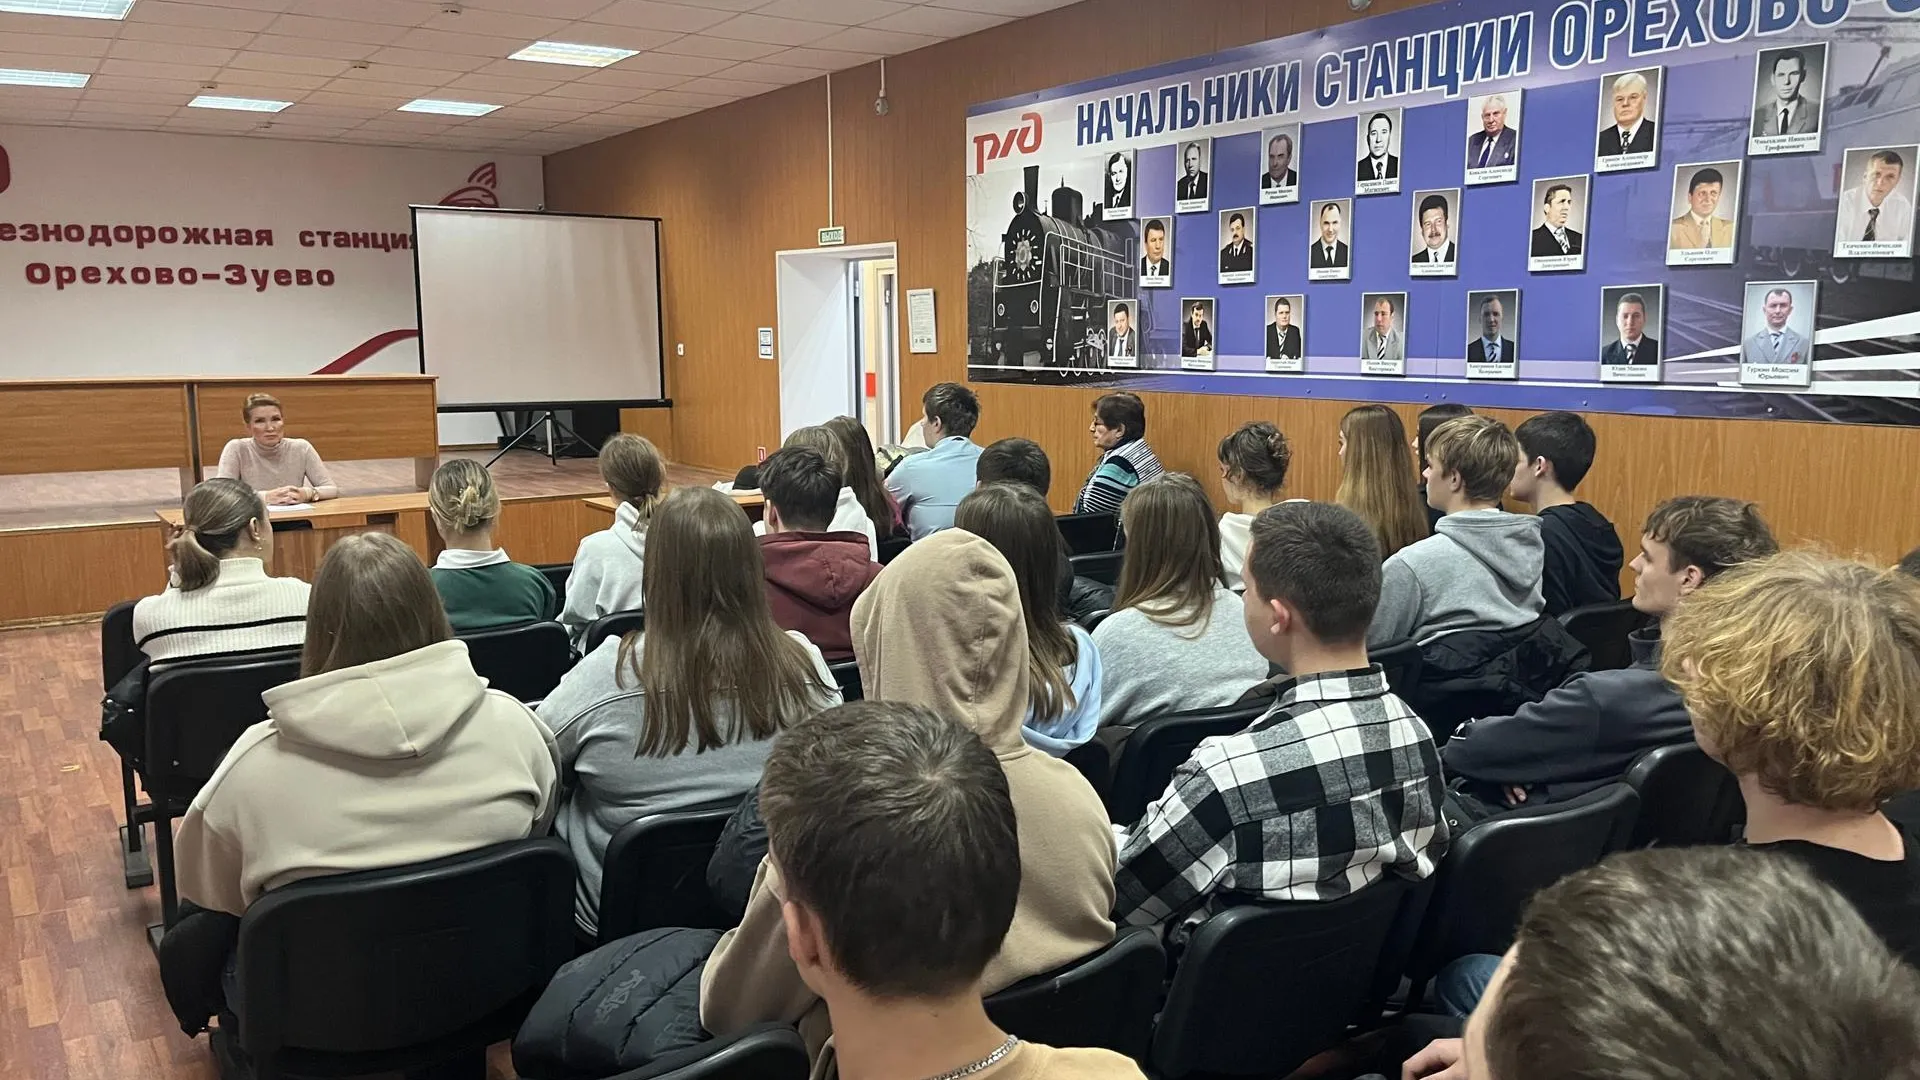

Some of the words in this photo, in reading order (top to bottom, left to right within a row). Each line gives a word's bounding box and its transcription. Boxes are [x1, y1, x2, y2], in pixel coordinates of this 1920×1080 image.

[1075, 62, 1300, 147] НАЧАЛЬНИКИ
[1314, 13, 1532, 108] СТАНЦИИ
[821, 230, 843, 243] ВЫХОД
[25, 262, 335, 292] Орехово-Зуево
